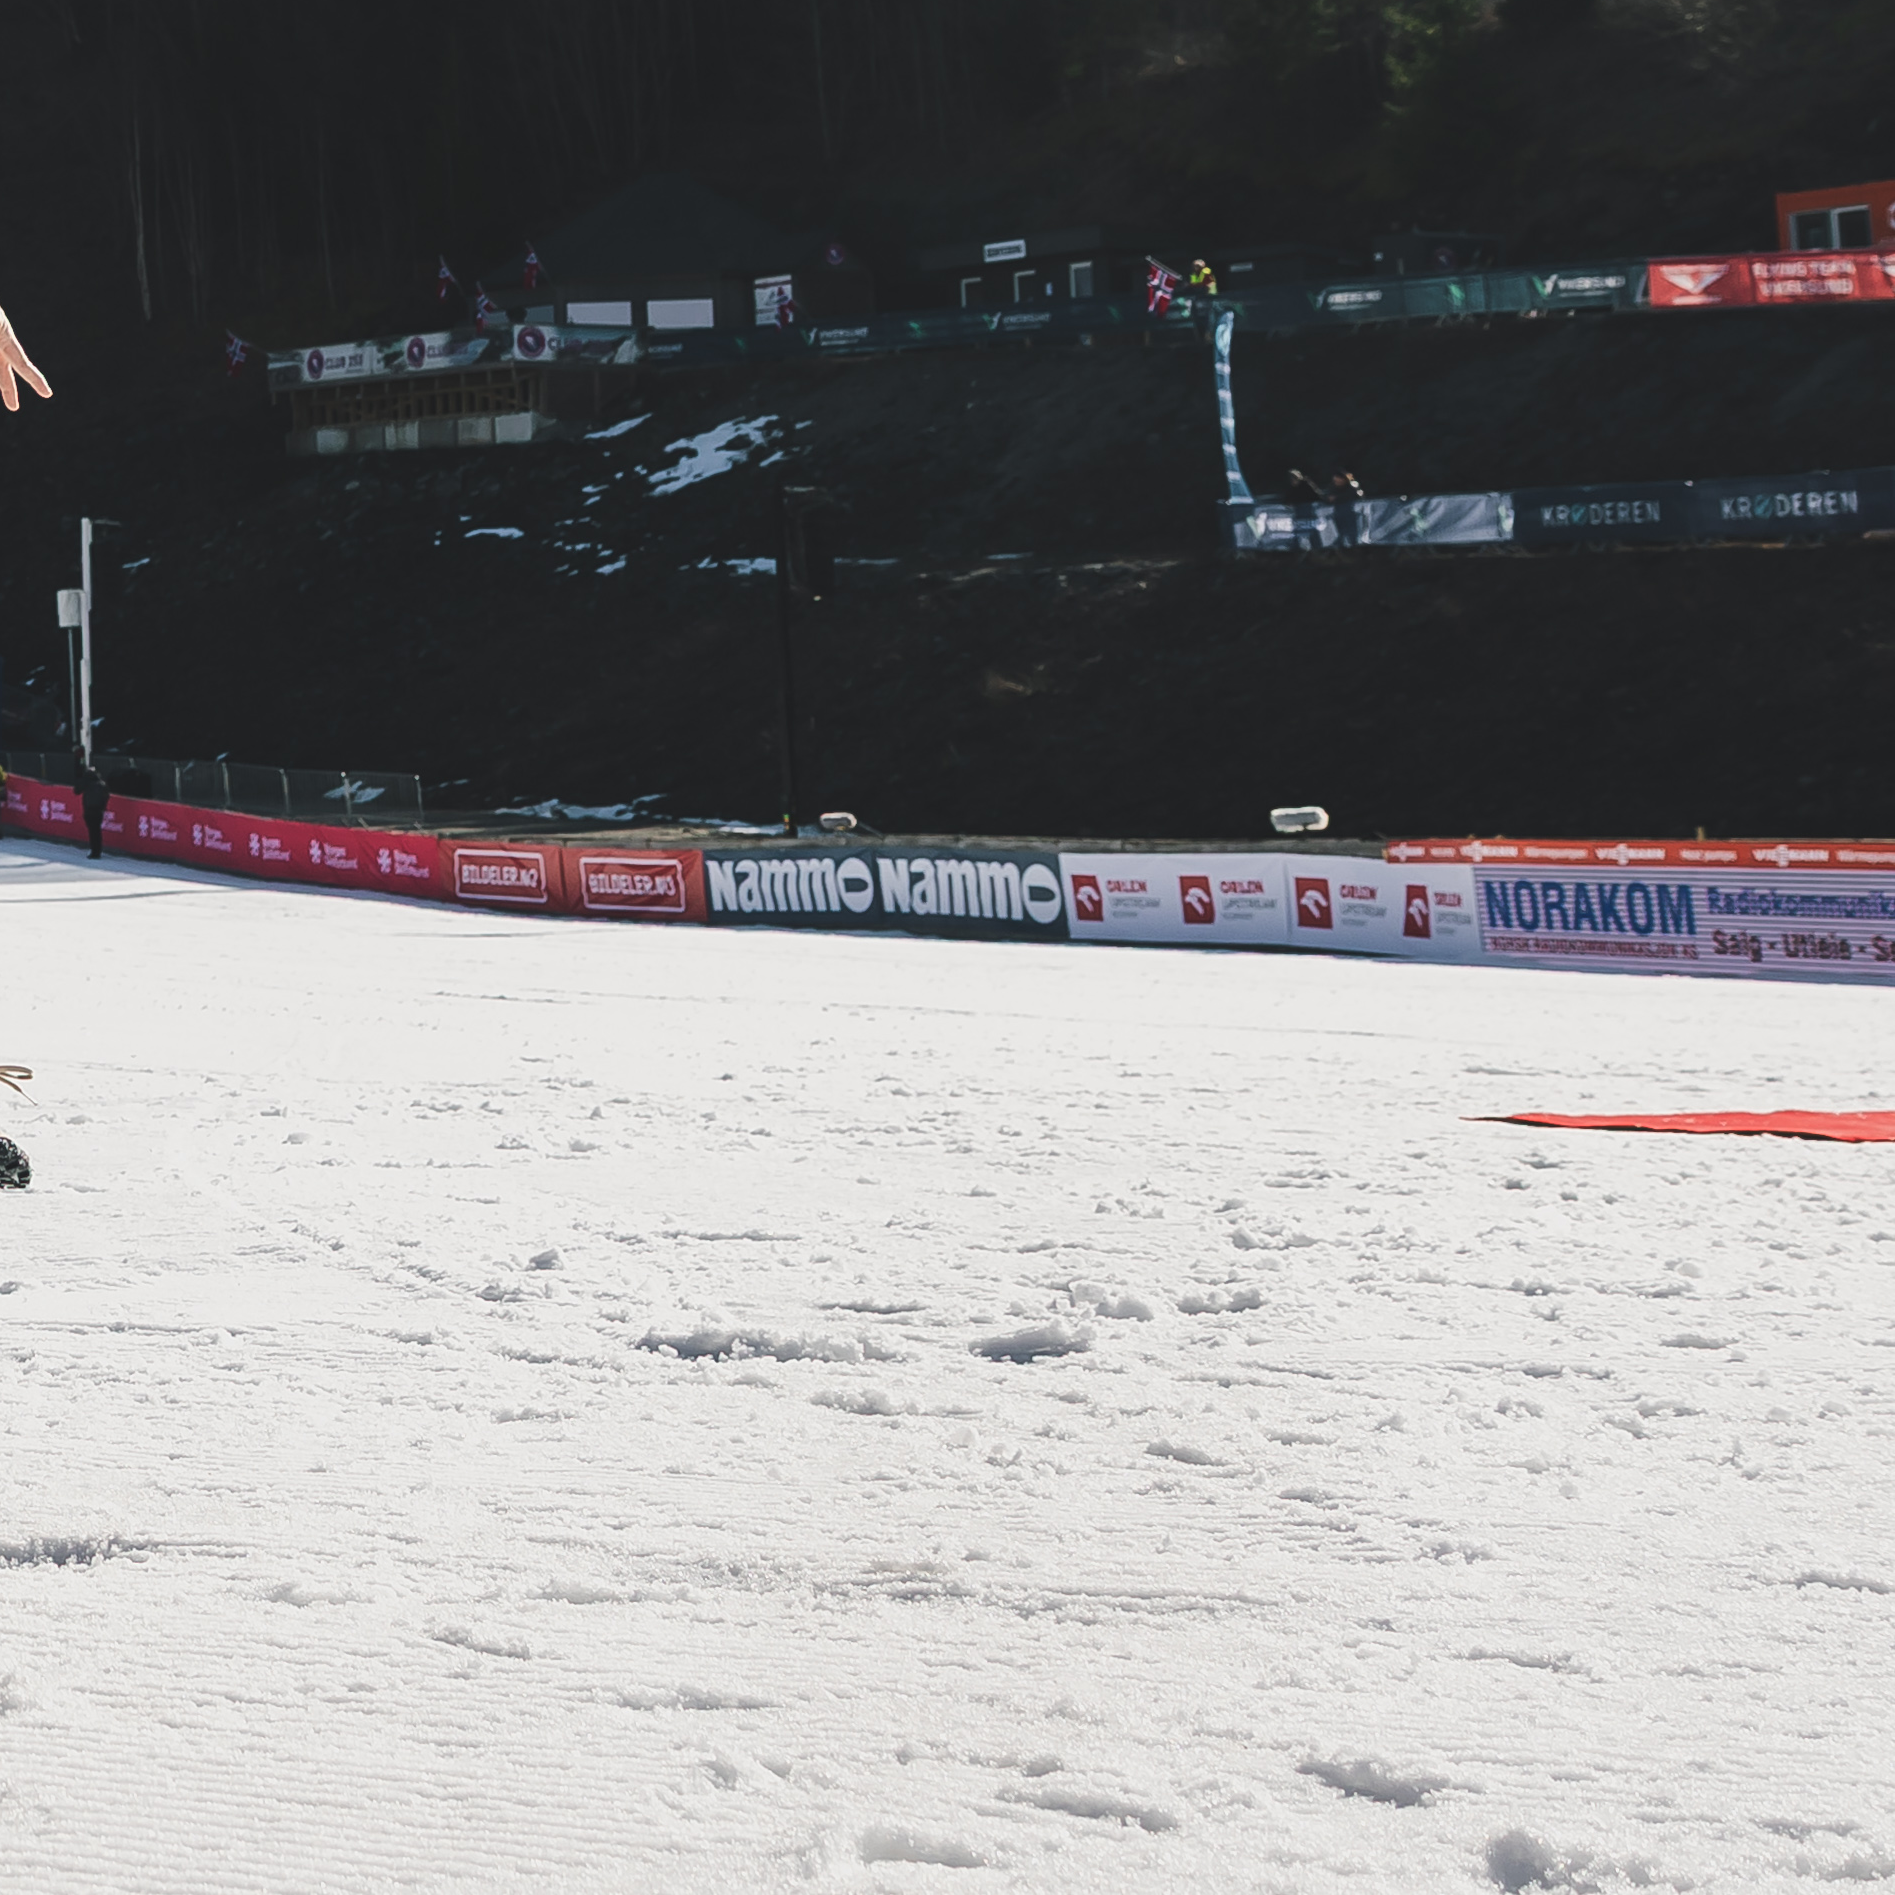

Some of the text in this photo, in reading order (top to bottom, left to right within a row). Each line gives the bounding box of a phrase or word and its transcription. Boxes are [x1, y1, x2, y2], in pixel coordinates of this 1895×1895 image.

[707, 856, 1062, 925] Nammo Nammo
[1484, 880, 1698, 936] NORAKOM
